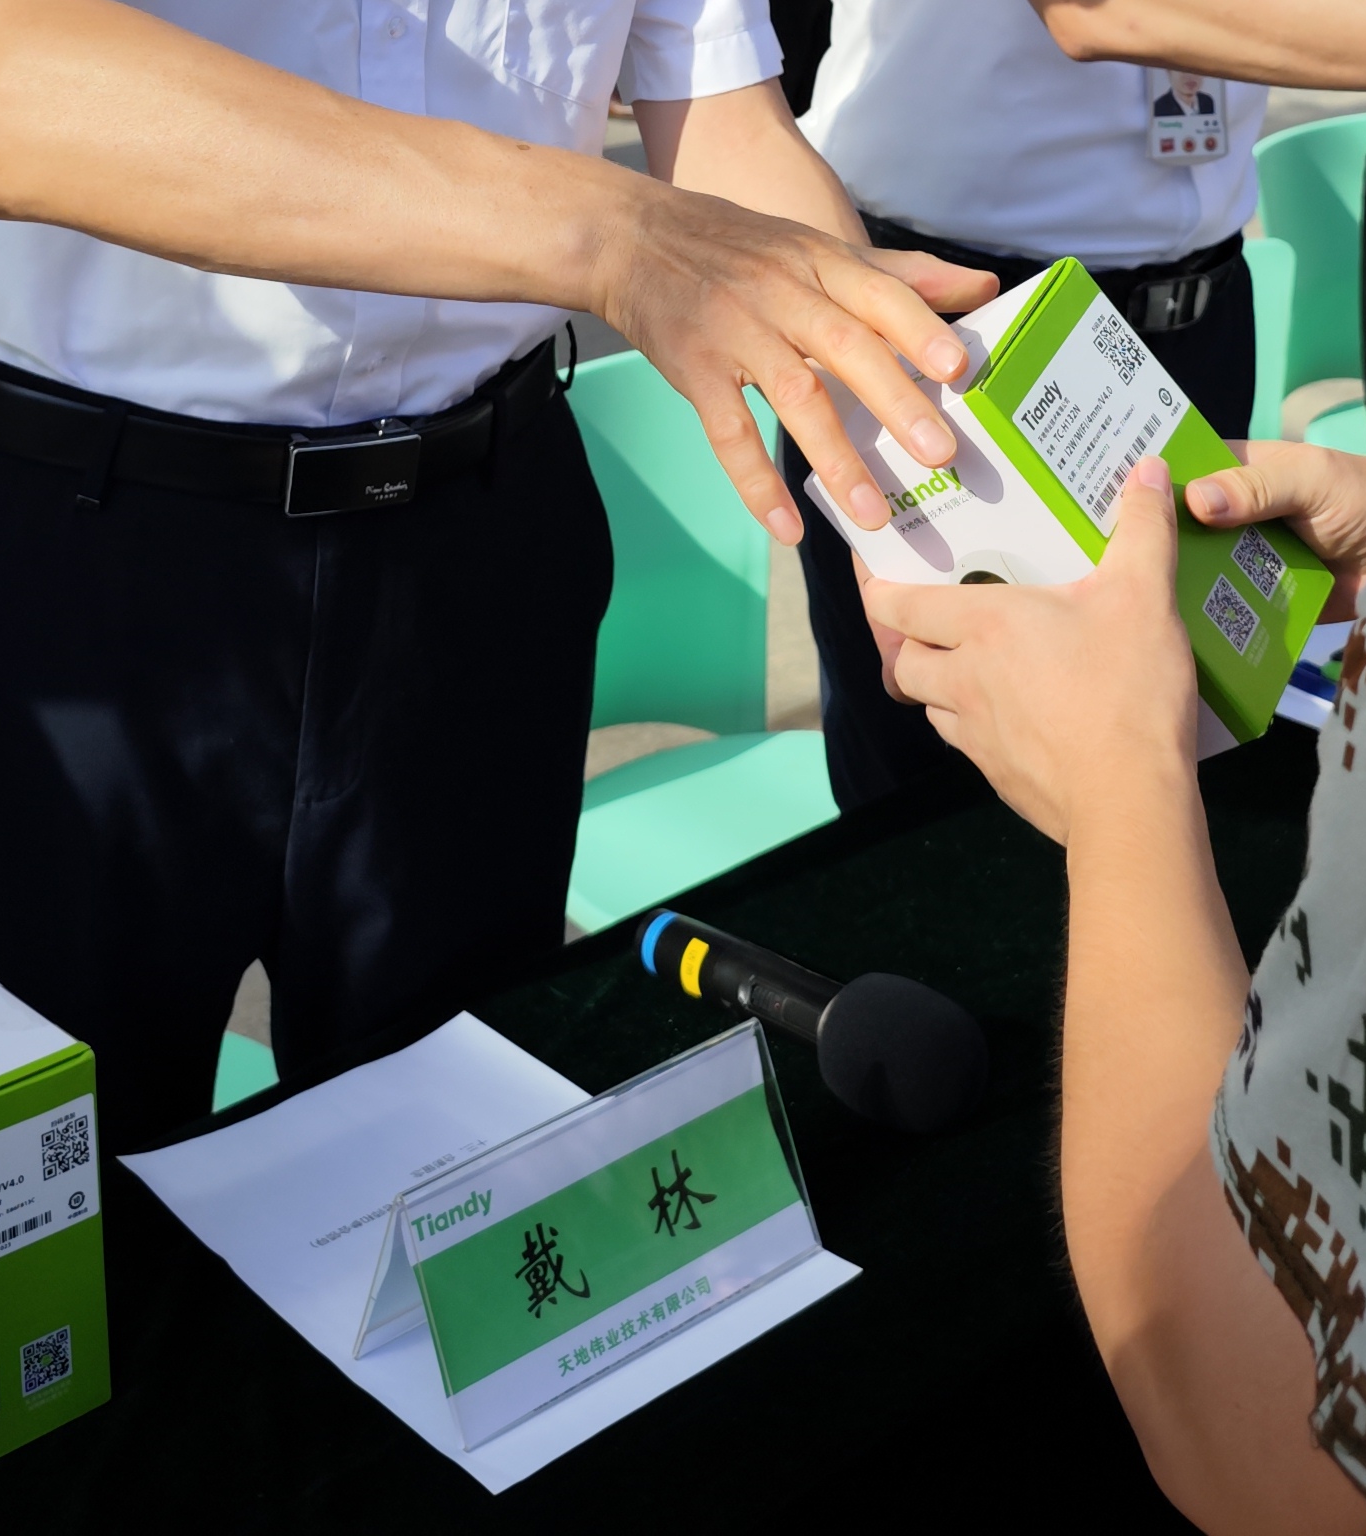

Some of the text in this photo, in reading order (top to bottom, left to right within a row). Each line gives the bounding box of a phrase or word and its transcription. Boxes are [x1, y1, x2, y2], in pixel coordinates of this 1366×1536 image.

[1021, 380, 1062, 431] Tiandy
[1038, 396, 1070, 444] 天地伟业技术有限公司
[1053, 404, 1081, 443] TC-H132N
[885, 466, 962, 517] iandy
[411, 1189, 492, 1242] Tiandy
[515, 1149, 718, 1319] 戴 林
[557, 1275, 713, 1377] 天地伟业技术有限公司
